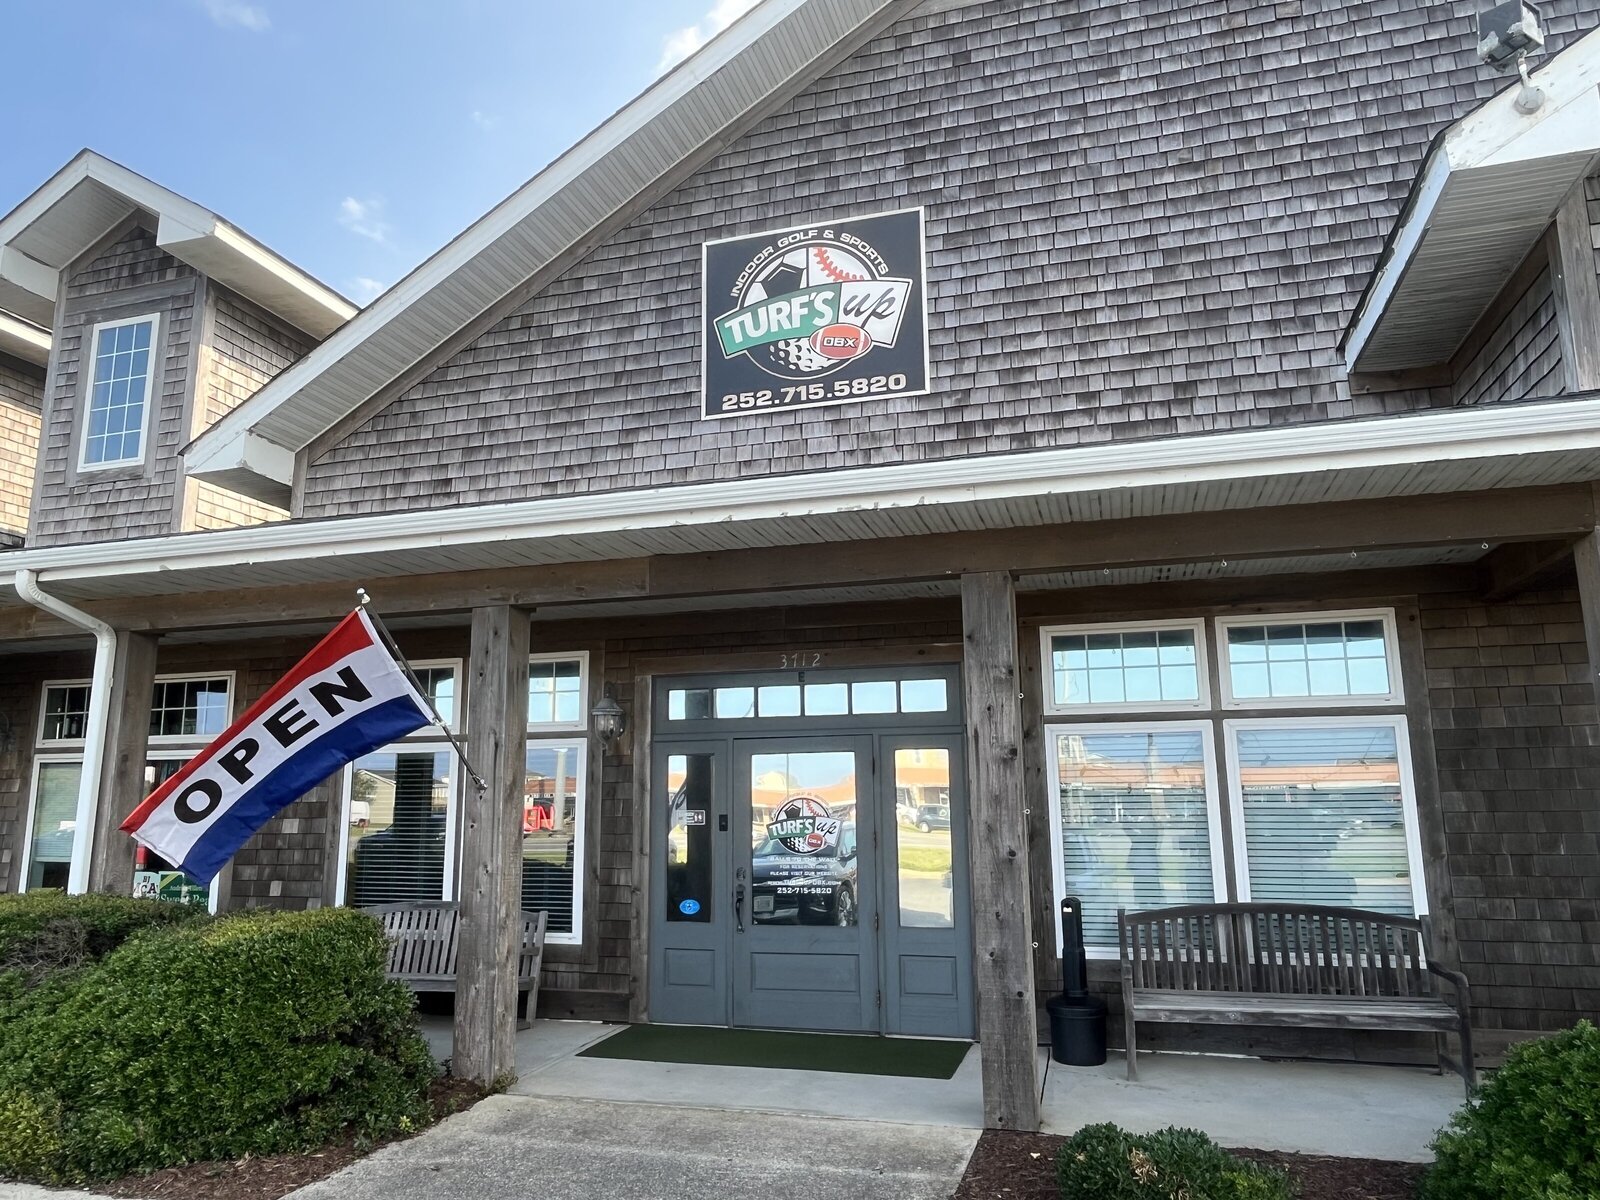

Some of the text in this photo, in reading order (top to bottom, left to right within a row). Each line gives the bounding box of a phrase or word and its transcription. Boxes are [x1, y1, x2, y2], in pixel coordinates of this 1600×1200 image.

[730, 230, 889, 297] INDOOR GOLF & SPORTS
[724, 287, 896, 344] TURF'S up
[823, 336, 859, 348] OBX
[722, 373, 907, 411] 252.715.5820
[780, 653, 820, 669] 3712
[174, 665, 373, 824] OPEN
[769, 818, 837, 837] TURF'S up
